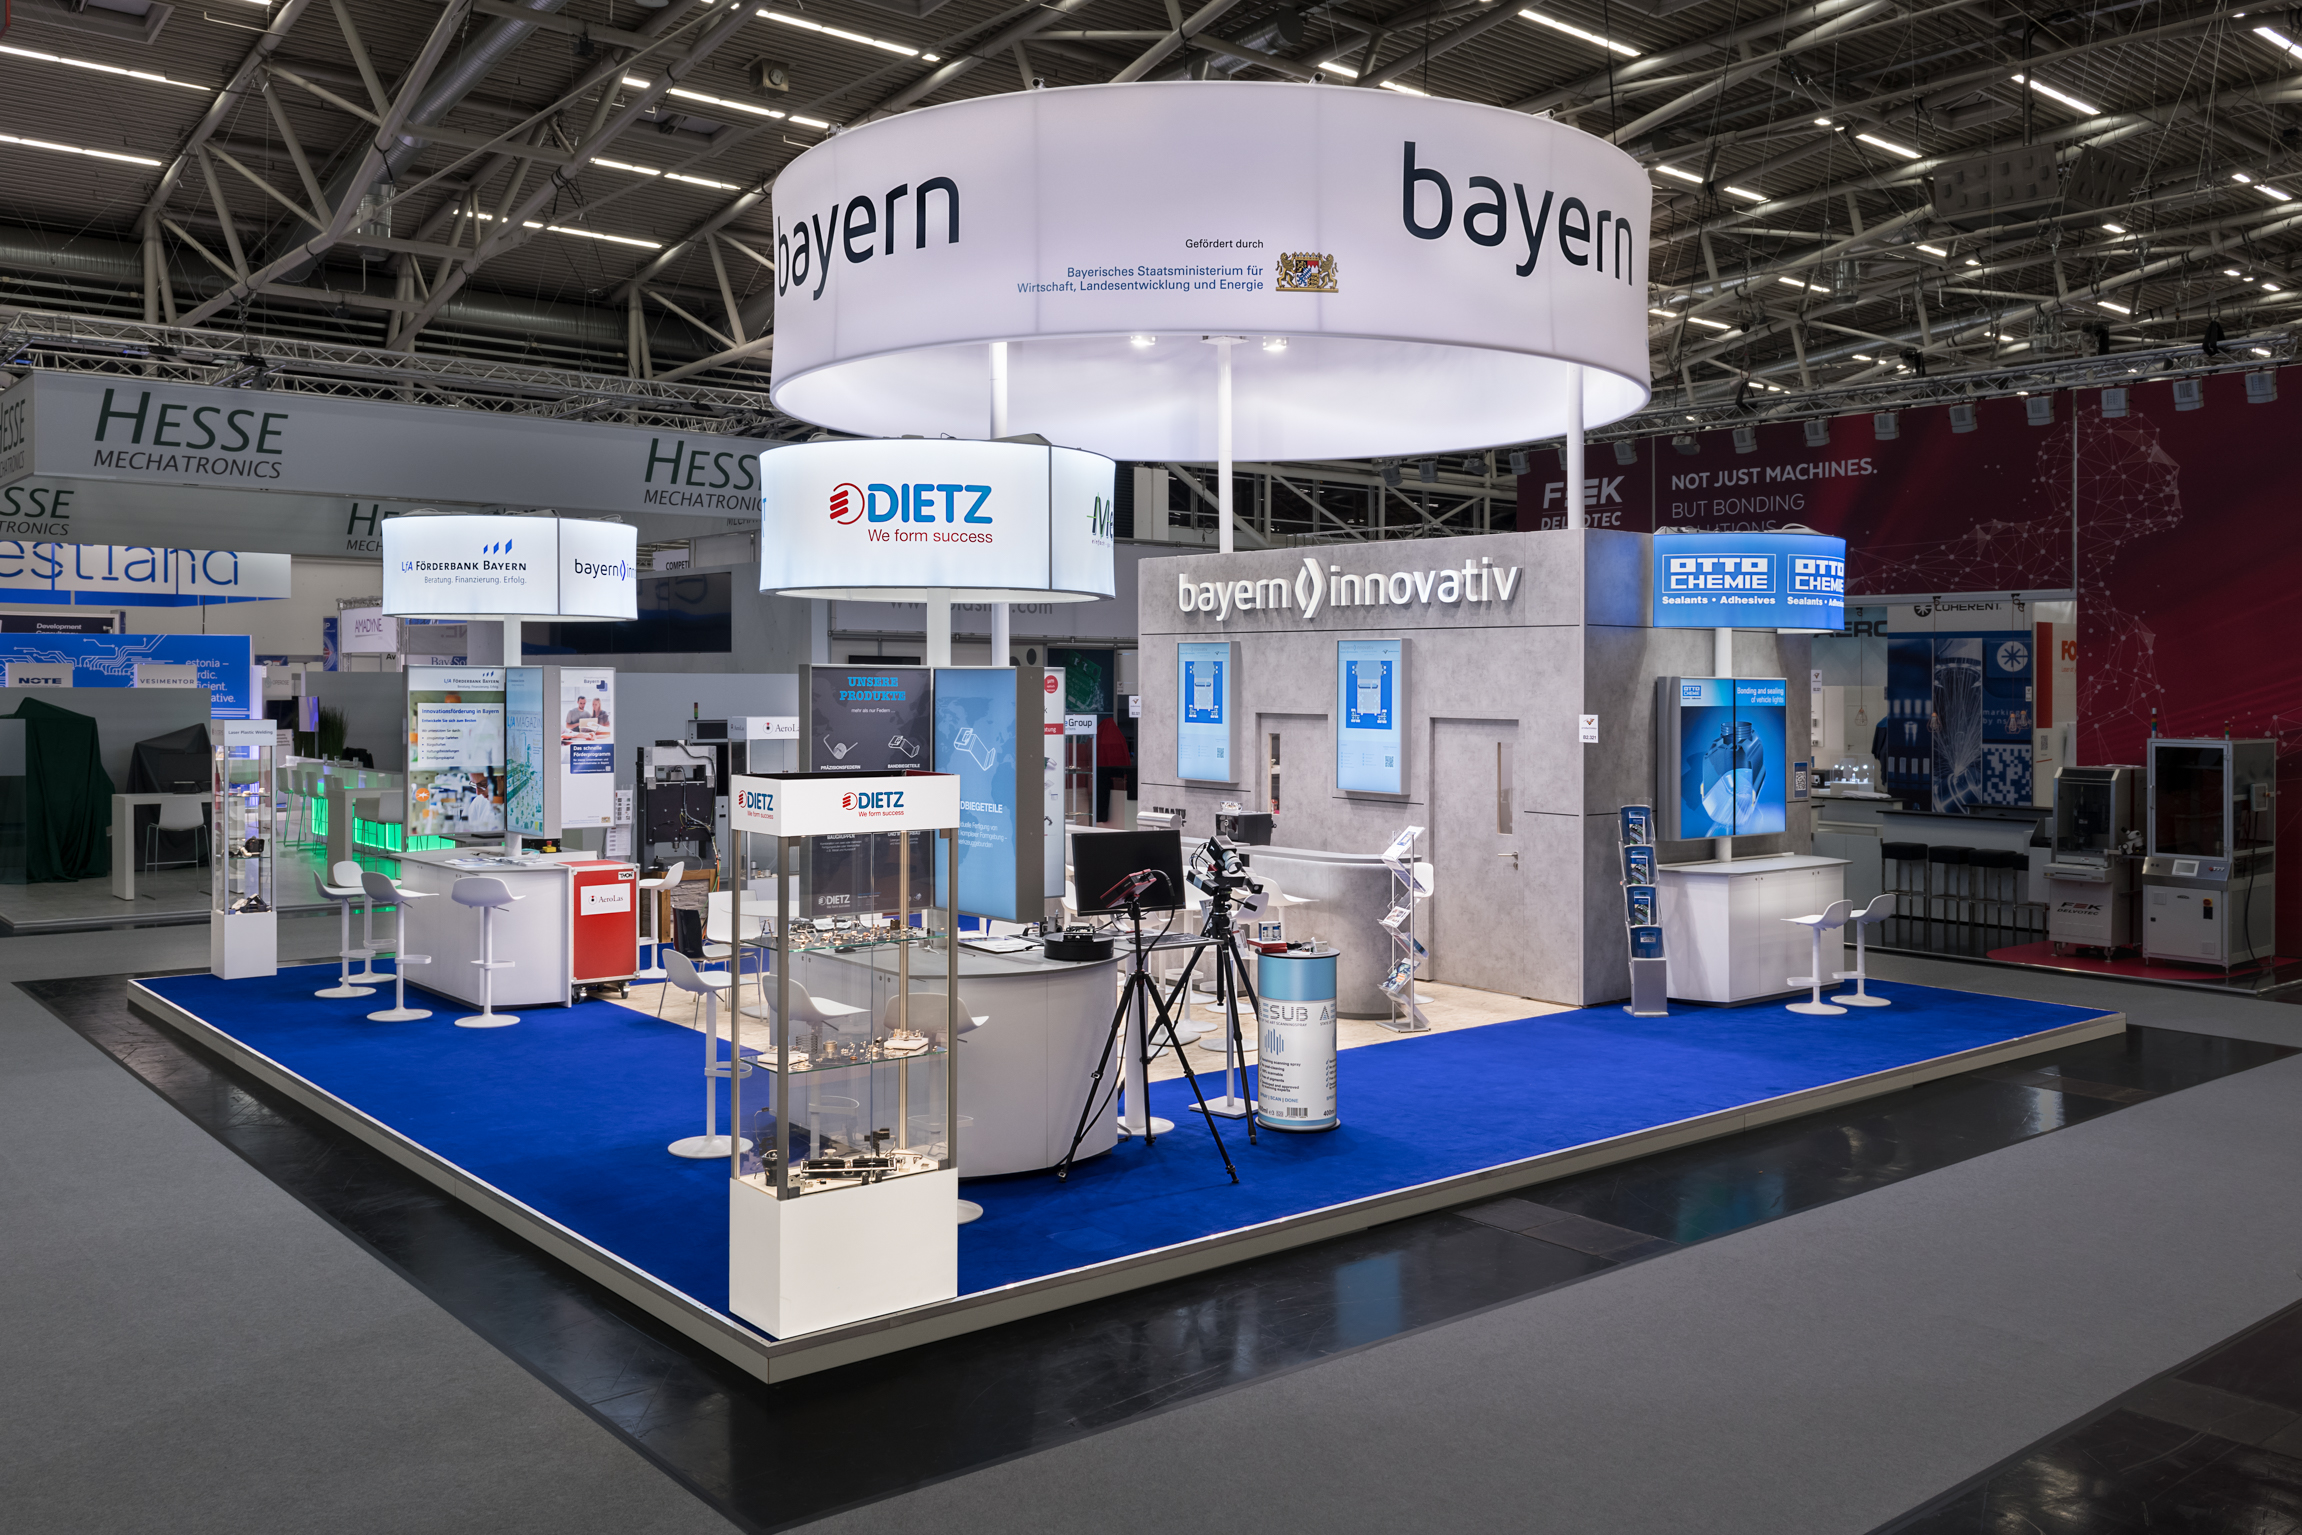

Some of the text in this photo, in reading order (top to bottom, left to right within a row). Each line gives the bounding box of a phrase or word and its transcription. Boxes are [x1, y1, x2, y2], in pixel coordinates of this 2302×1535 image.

[1402, 140, 1633, 286] bayern
[777, 176, 960, 300] bayern
[1185, 238, 1264, 249] Gefördert durch
[1067, 265, 1263, 278] Bayerisches Staatsministerium für
[1017, 279, 1264, 293] Wirtschaft, Landesentwicklung und Energie
[94, 387, 289, 455] HESSE
[93, 449, 282, 479] MECHATRONICS
[644, 438, 761, 491] HESS
[1672, 457, 1878, 490] NOT JUST MACHINES.
[643, 489, 763, 512] MECHATRONIC
[868, 483, 993, 524] DIETZ
[1672, 493, 1805, 518] BUT BONDING
[1541, 512, 1622, 530] DELOTEC
[868, 528, 993, 543] We form success
[401, 561, 413, 573] LfA
[575, 559, 618, 579] bayern
[1670, 558, 1768, 572] OTTO
[1795, 559, 1844, 577] OTTO
[424, 576, 527, 585] Beratung. Finanzierung. Erfolg.
[1670, 575, 1768, 589] CHEMIE
[1795, 576, 1844, 593] CHEMIE
[1179, 556, 1523, 621] bayern innovativ
[1662, 595, 1776, 604] Sealants Adhesives
[1787, 596, 1823, 606] Sealants
[37, 622, 82, 630] Development
[186, 658, 220, 668] estonia
[197, 670, 218, 679] rdic.
[848, 676, 898, 688] UNSERE
[211, 693, 236, 702] ative.
[839, 691, 906, 701] PRODUKTE
[1737, 687, 1757, 695] Bonding
[1767, 687, 1784, 696] sealing
[1772, 696, 1784, 704] lights
[775, 724, 799, 733] AeroL
[747, 792, 773, 811] DIETZ
[858, 791, 904, 809] DIETZ
[826, 894, 850, 905] DIETZ
[2057, 908, 2099, 916] DELVOTEC
